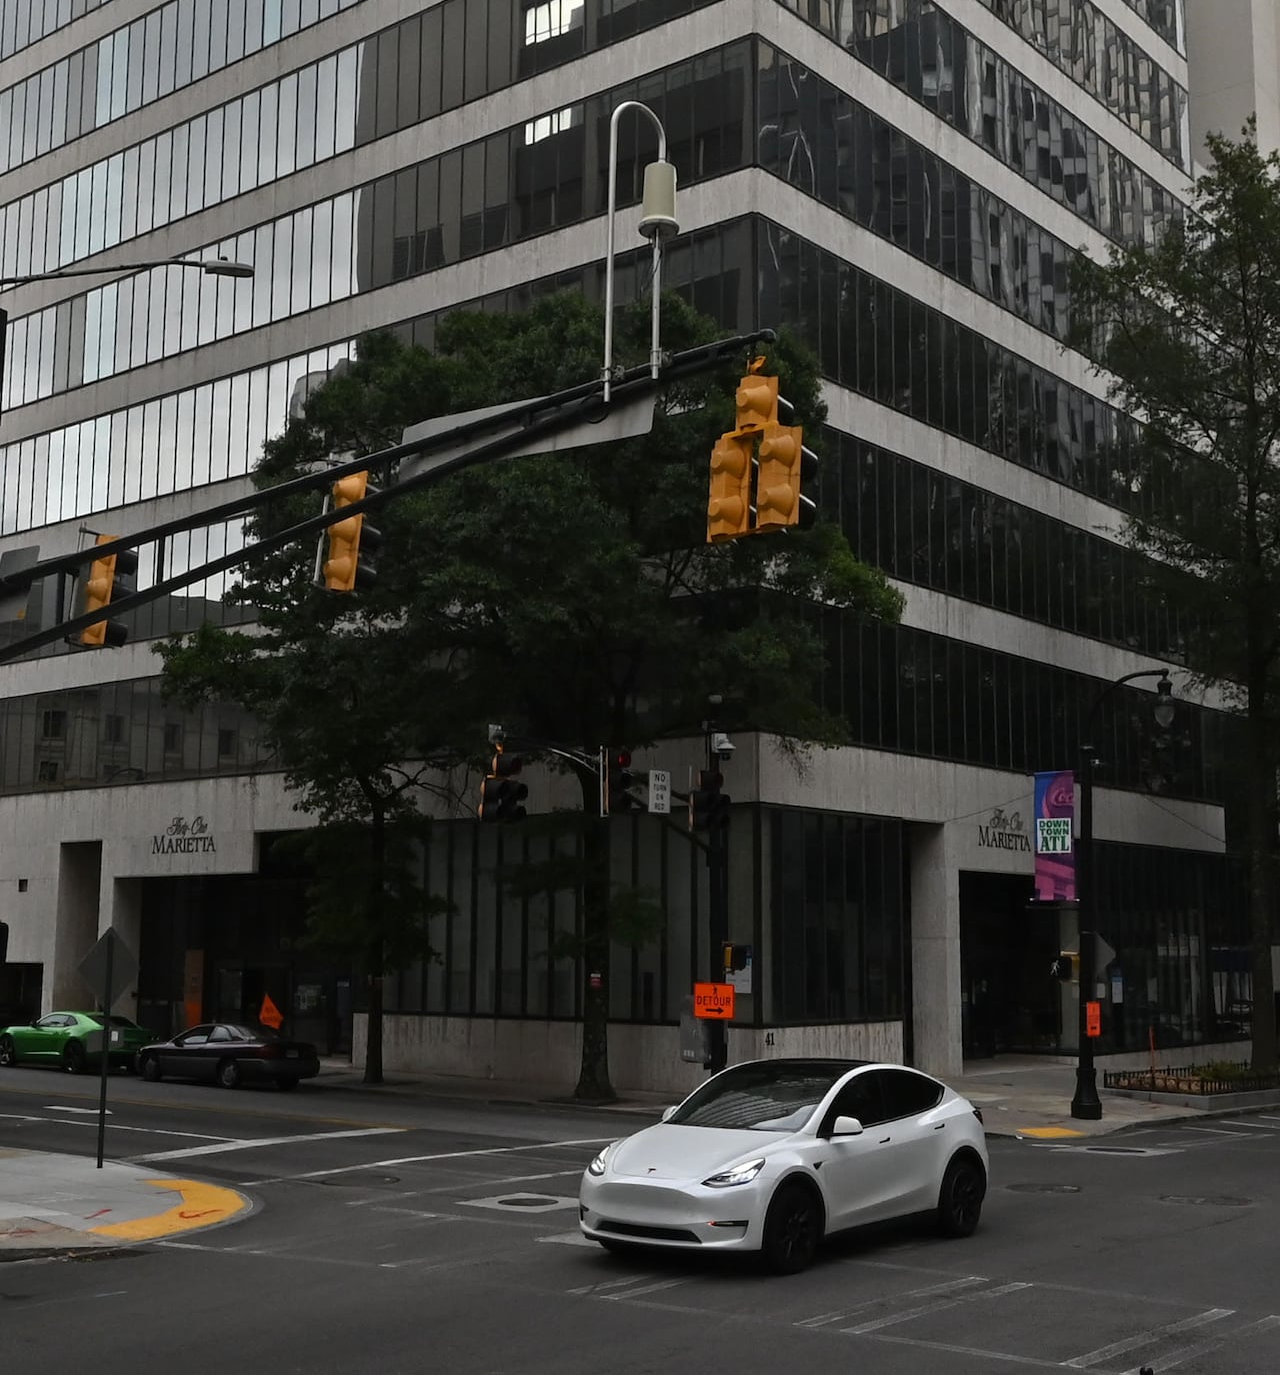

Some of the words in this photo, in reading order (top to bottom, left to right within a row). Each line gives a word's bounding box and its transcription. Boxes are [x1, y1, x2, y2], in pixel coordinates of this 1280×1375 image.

[654, 773, 666, 782] NO
[1040, 820, 1069, 828] DOWN
[1040, 828, 1069, 836] TOWN
[152, 834, 216, 855] MARIETTA
[979, 824, 1031, 853] MARIETTA
[1040, 836, 1070, 852] ATL
[696, 995, 731, 1006] DETOUR
[765, 1033, 775, 1046] 41
